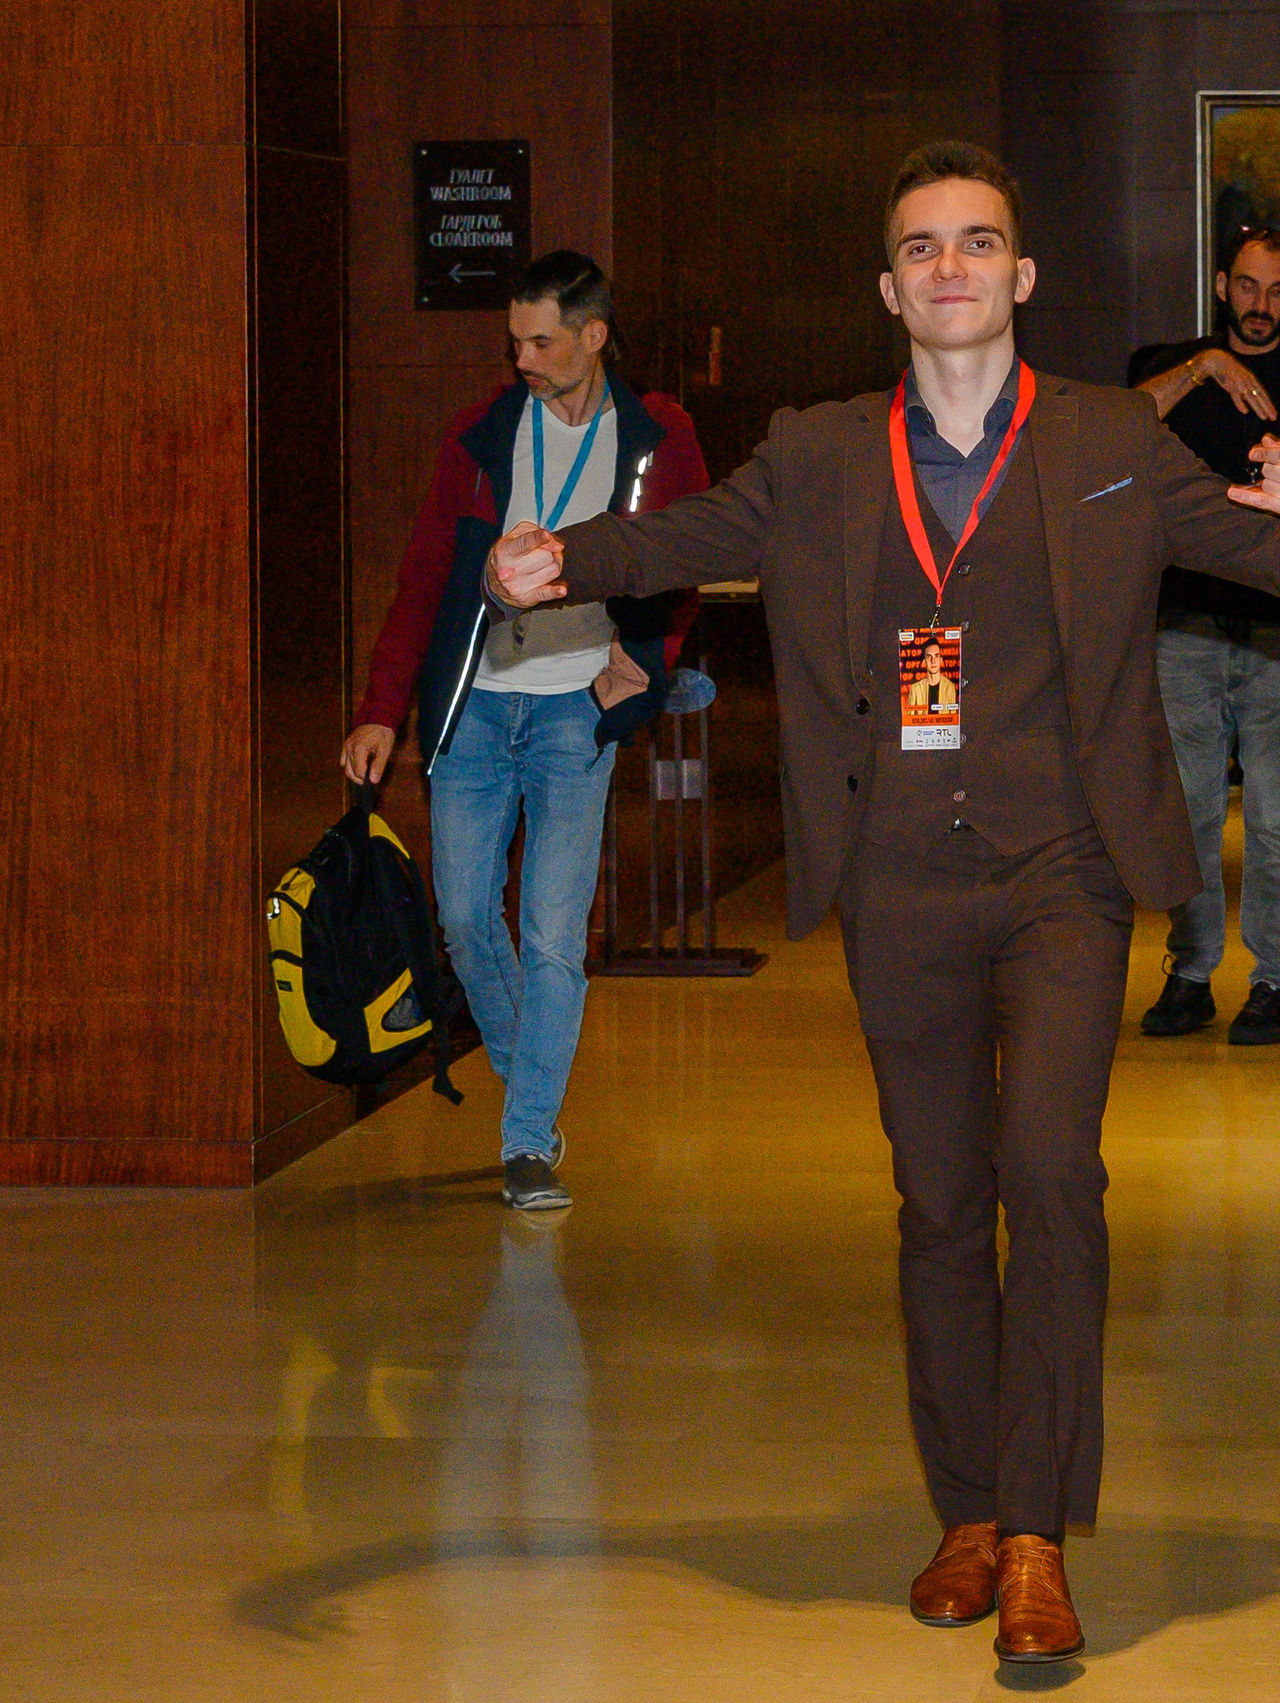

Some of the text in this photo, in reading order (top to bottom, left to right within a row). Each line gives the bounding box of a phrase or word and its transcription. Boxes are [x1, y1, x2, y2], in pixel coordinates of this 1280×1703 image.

[430, 186, 512, 201] WASHROOM
[429, 232, 513, 247] CLOAKROOM
[936, 728, 952, 737] RTL
